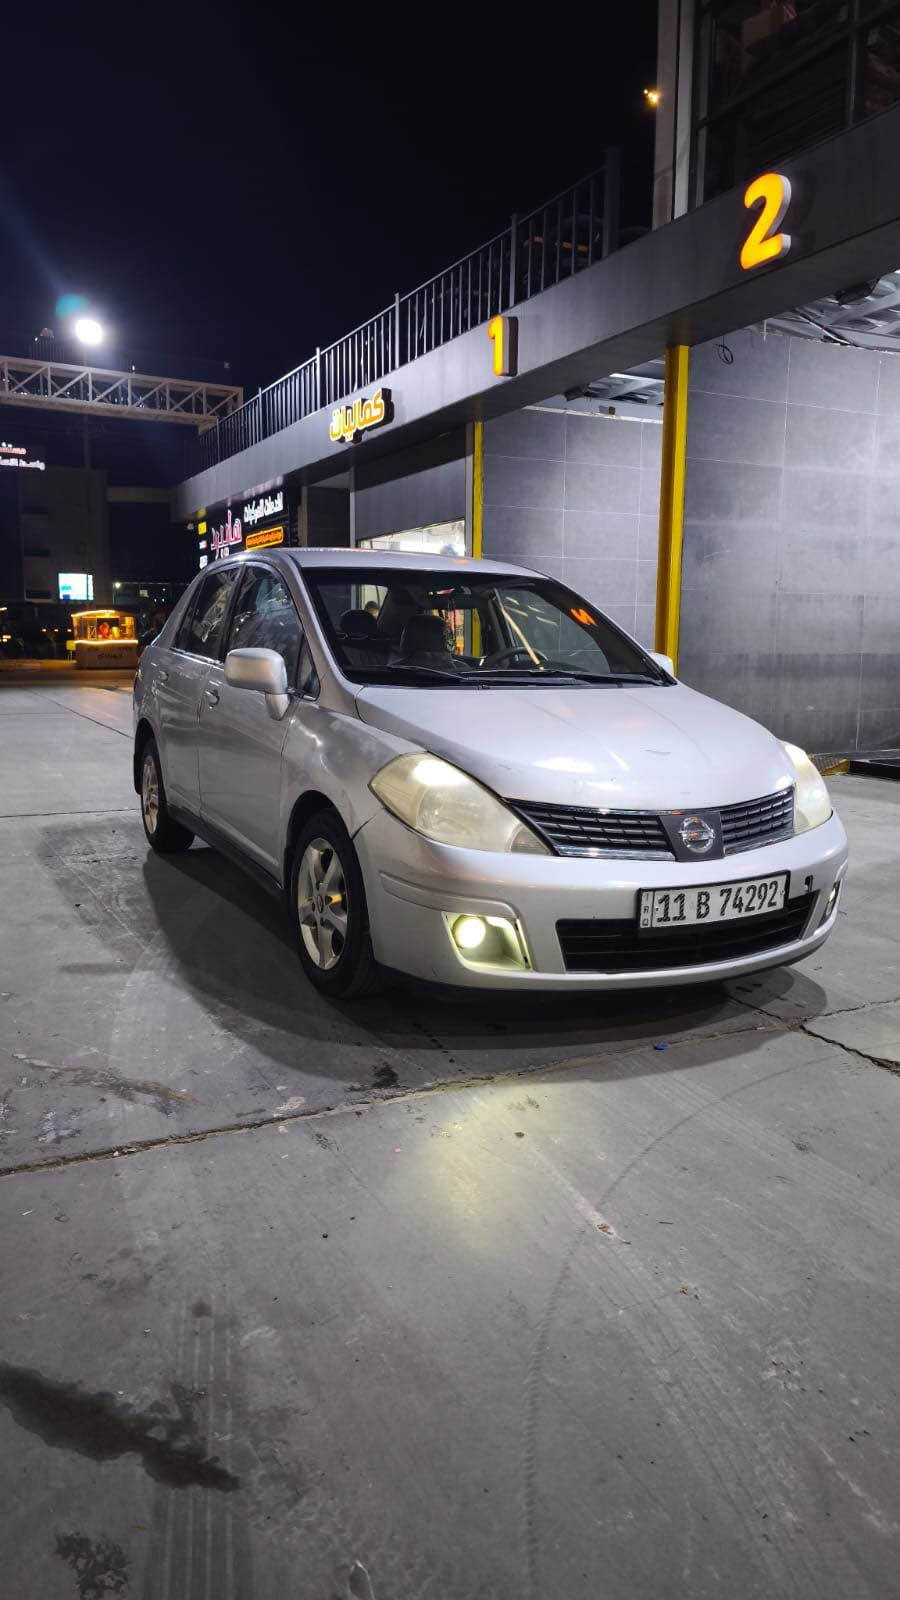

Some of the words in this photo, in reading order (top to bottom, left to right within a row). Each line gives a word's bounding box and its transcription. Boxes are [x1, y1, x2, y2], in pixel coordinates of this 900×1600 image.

[740, 172, 790, 270] 2
[487, 313, 511, 377] 1
[329, 388, 385, 442] كماليات
[656, 893, 687, 923] 11
[696, 890, 711, 920] B
[719, 880, 779, 917] 74292
